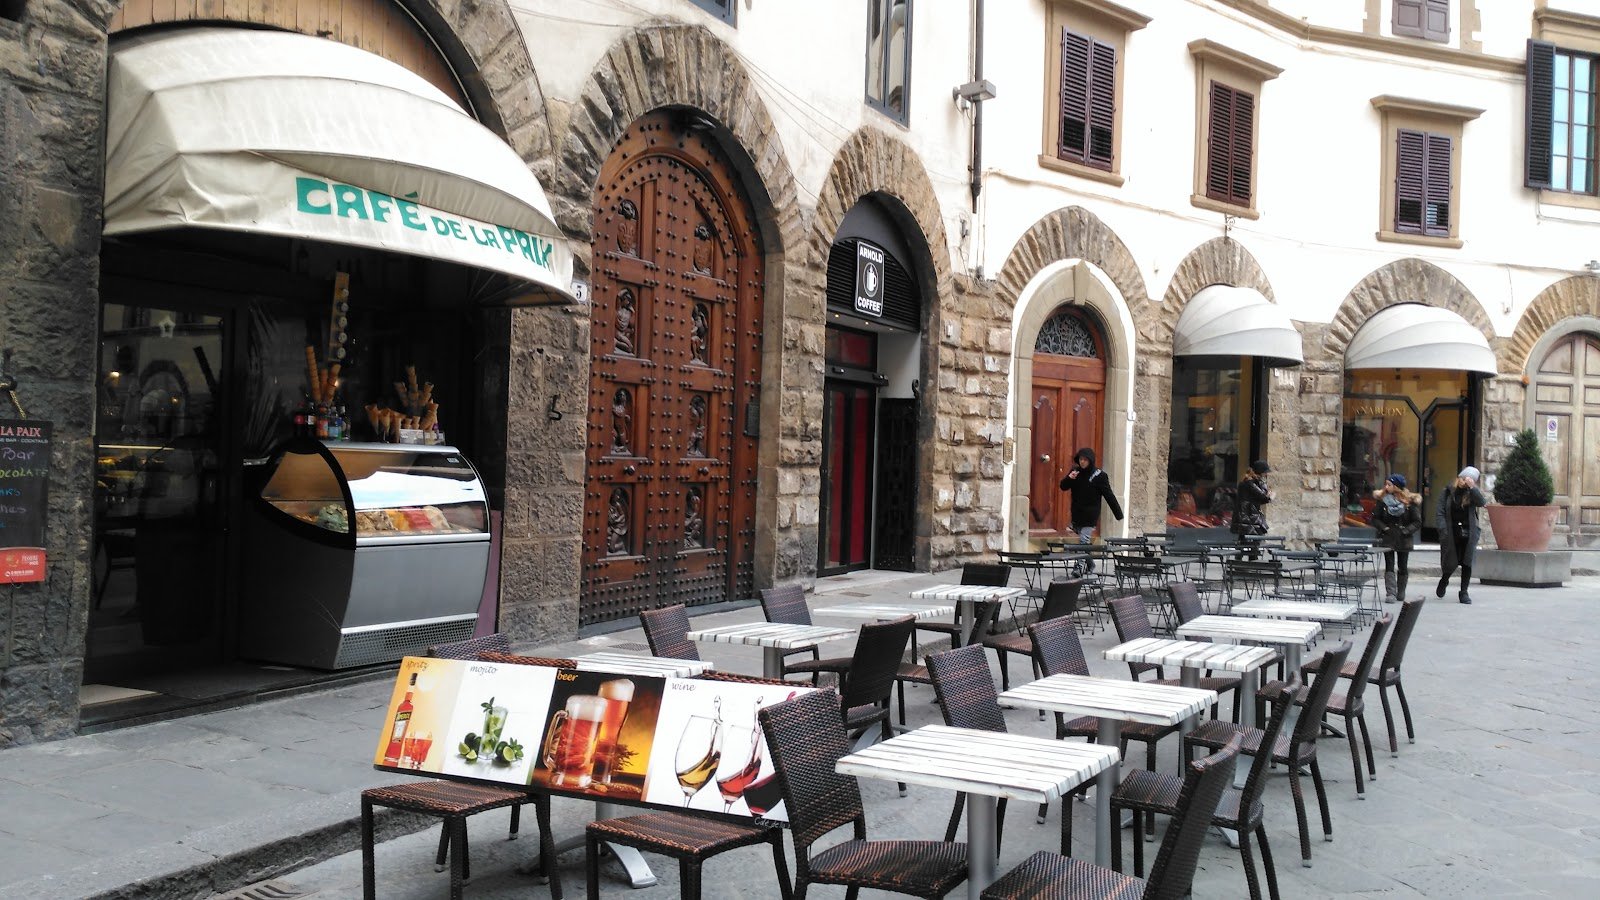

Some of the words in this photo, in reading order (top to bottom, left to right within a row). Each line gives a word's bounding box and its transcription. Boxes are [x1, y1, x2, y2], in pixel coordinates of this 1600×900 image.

[296, 177, 426, 231] CAFÉ
[430, 216, 467, 240] DE
[469, 226, 501, 249] LA
[860, 246, 882, 263] ARNOLD
[576, 284, 583, 300] 5
[857, 296, 881, 312] COFFEE
[0, 426, 14, 436] LA
[16, 426, 41, 437] PAIX
[470, 665, 498, 675] mojito
[556, 669, 578, 682] beer
[671, 682, 696, 692] wine
